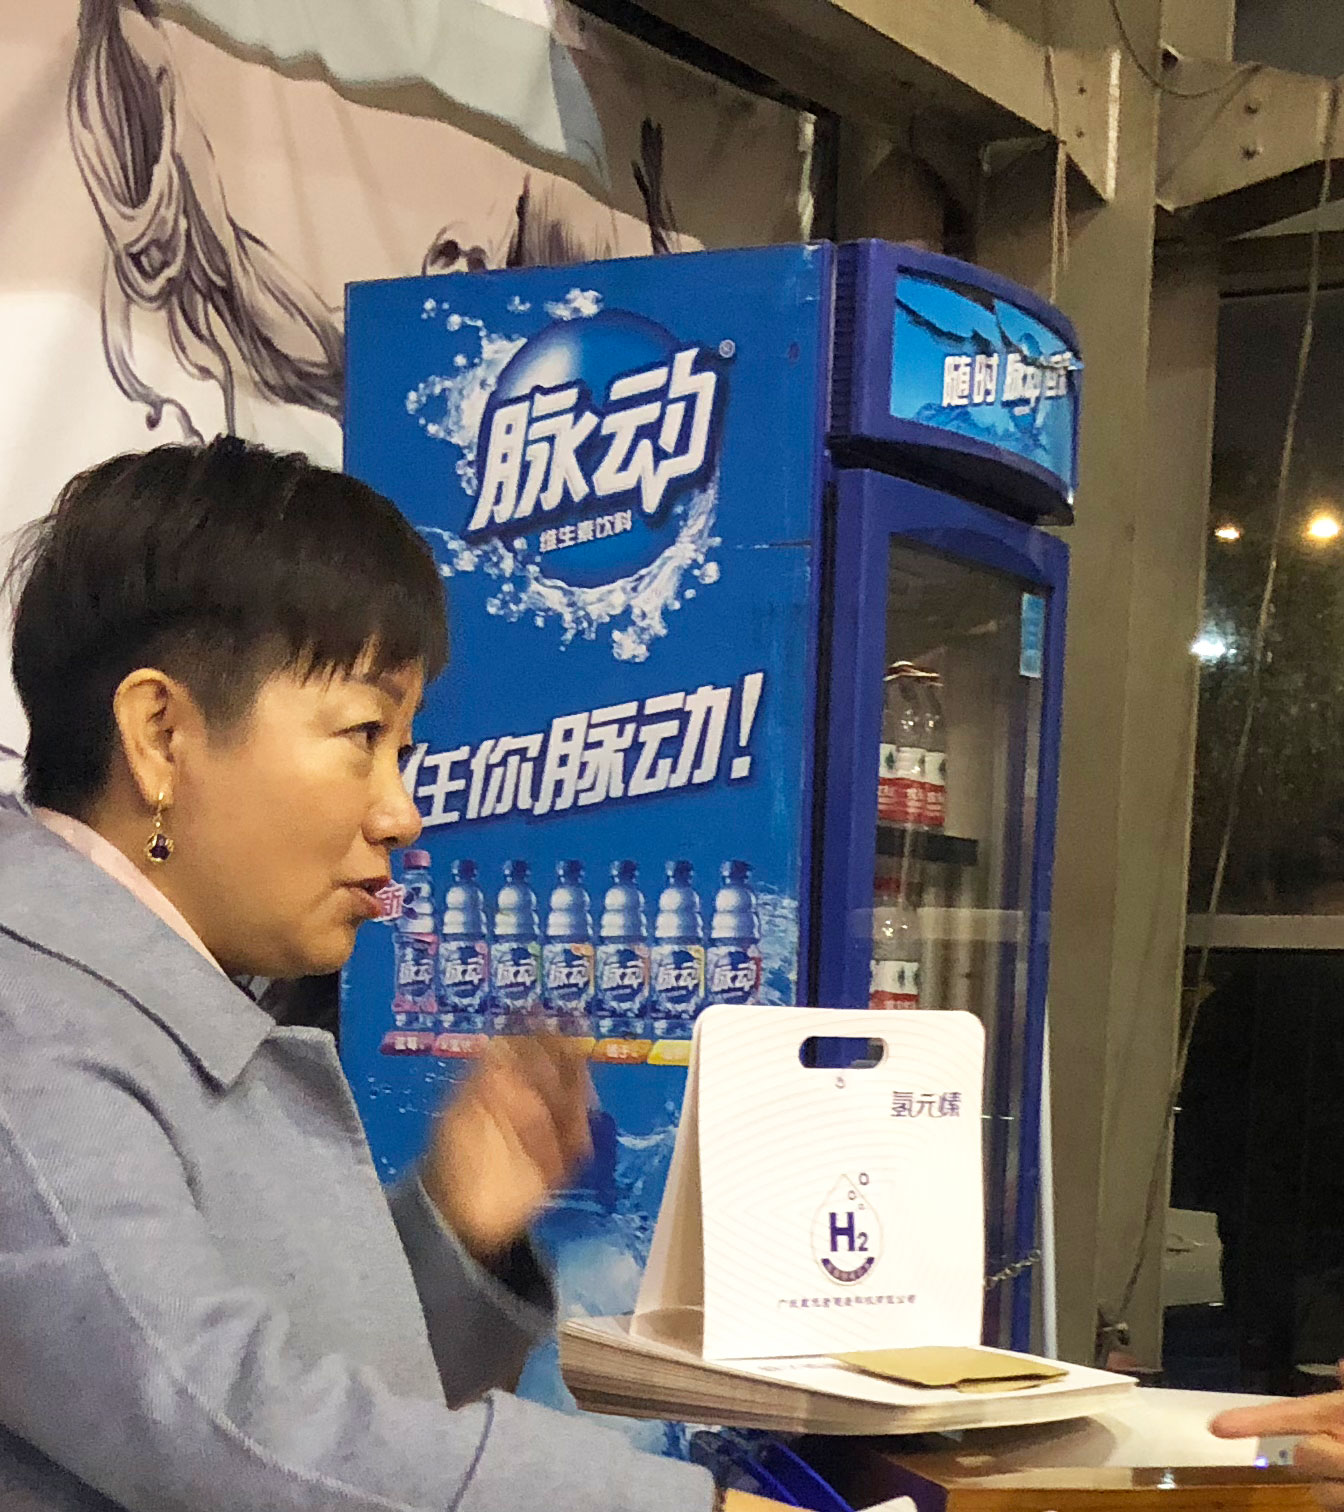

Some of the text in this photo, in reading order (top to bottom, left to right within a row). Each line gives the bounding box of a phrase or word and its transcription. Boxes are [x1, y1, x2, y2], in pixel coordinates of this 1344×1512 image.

[467, 347, 717, 531] 脉动
[539, 510, 633, 553] 维生素饮料
[829, 1212, 869, 1252] H2
